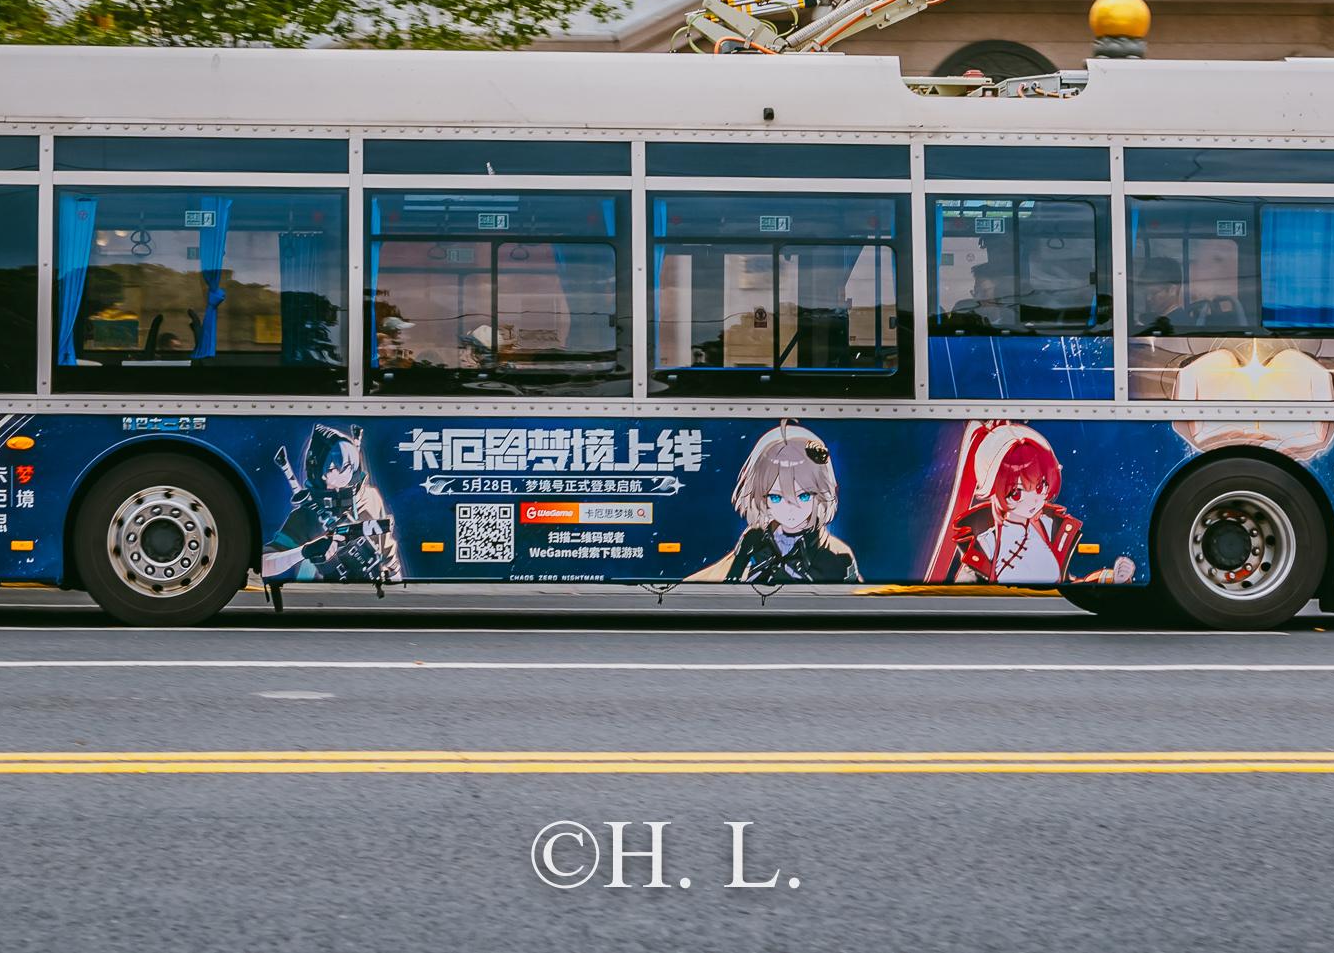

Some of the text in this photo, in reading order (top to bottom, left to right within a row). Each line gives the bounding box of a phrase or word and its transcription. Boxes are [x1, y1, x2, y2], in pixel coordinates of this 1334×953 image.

[399, 428, 703, 472] 卡厄思梦境上线
[15, 464, 35, 508] 梦境
[585, 508, 634, 519] 卡厄思梦境
[548, 531, 625, 544] 扫描二维码或者
